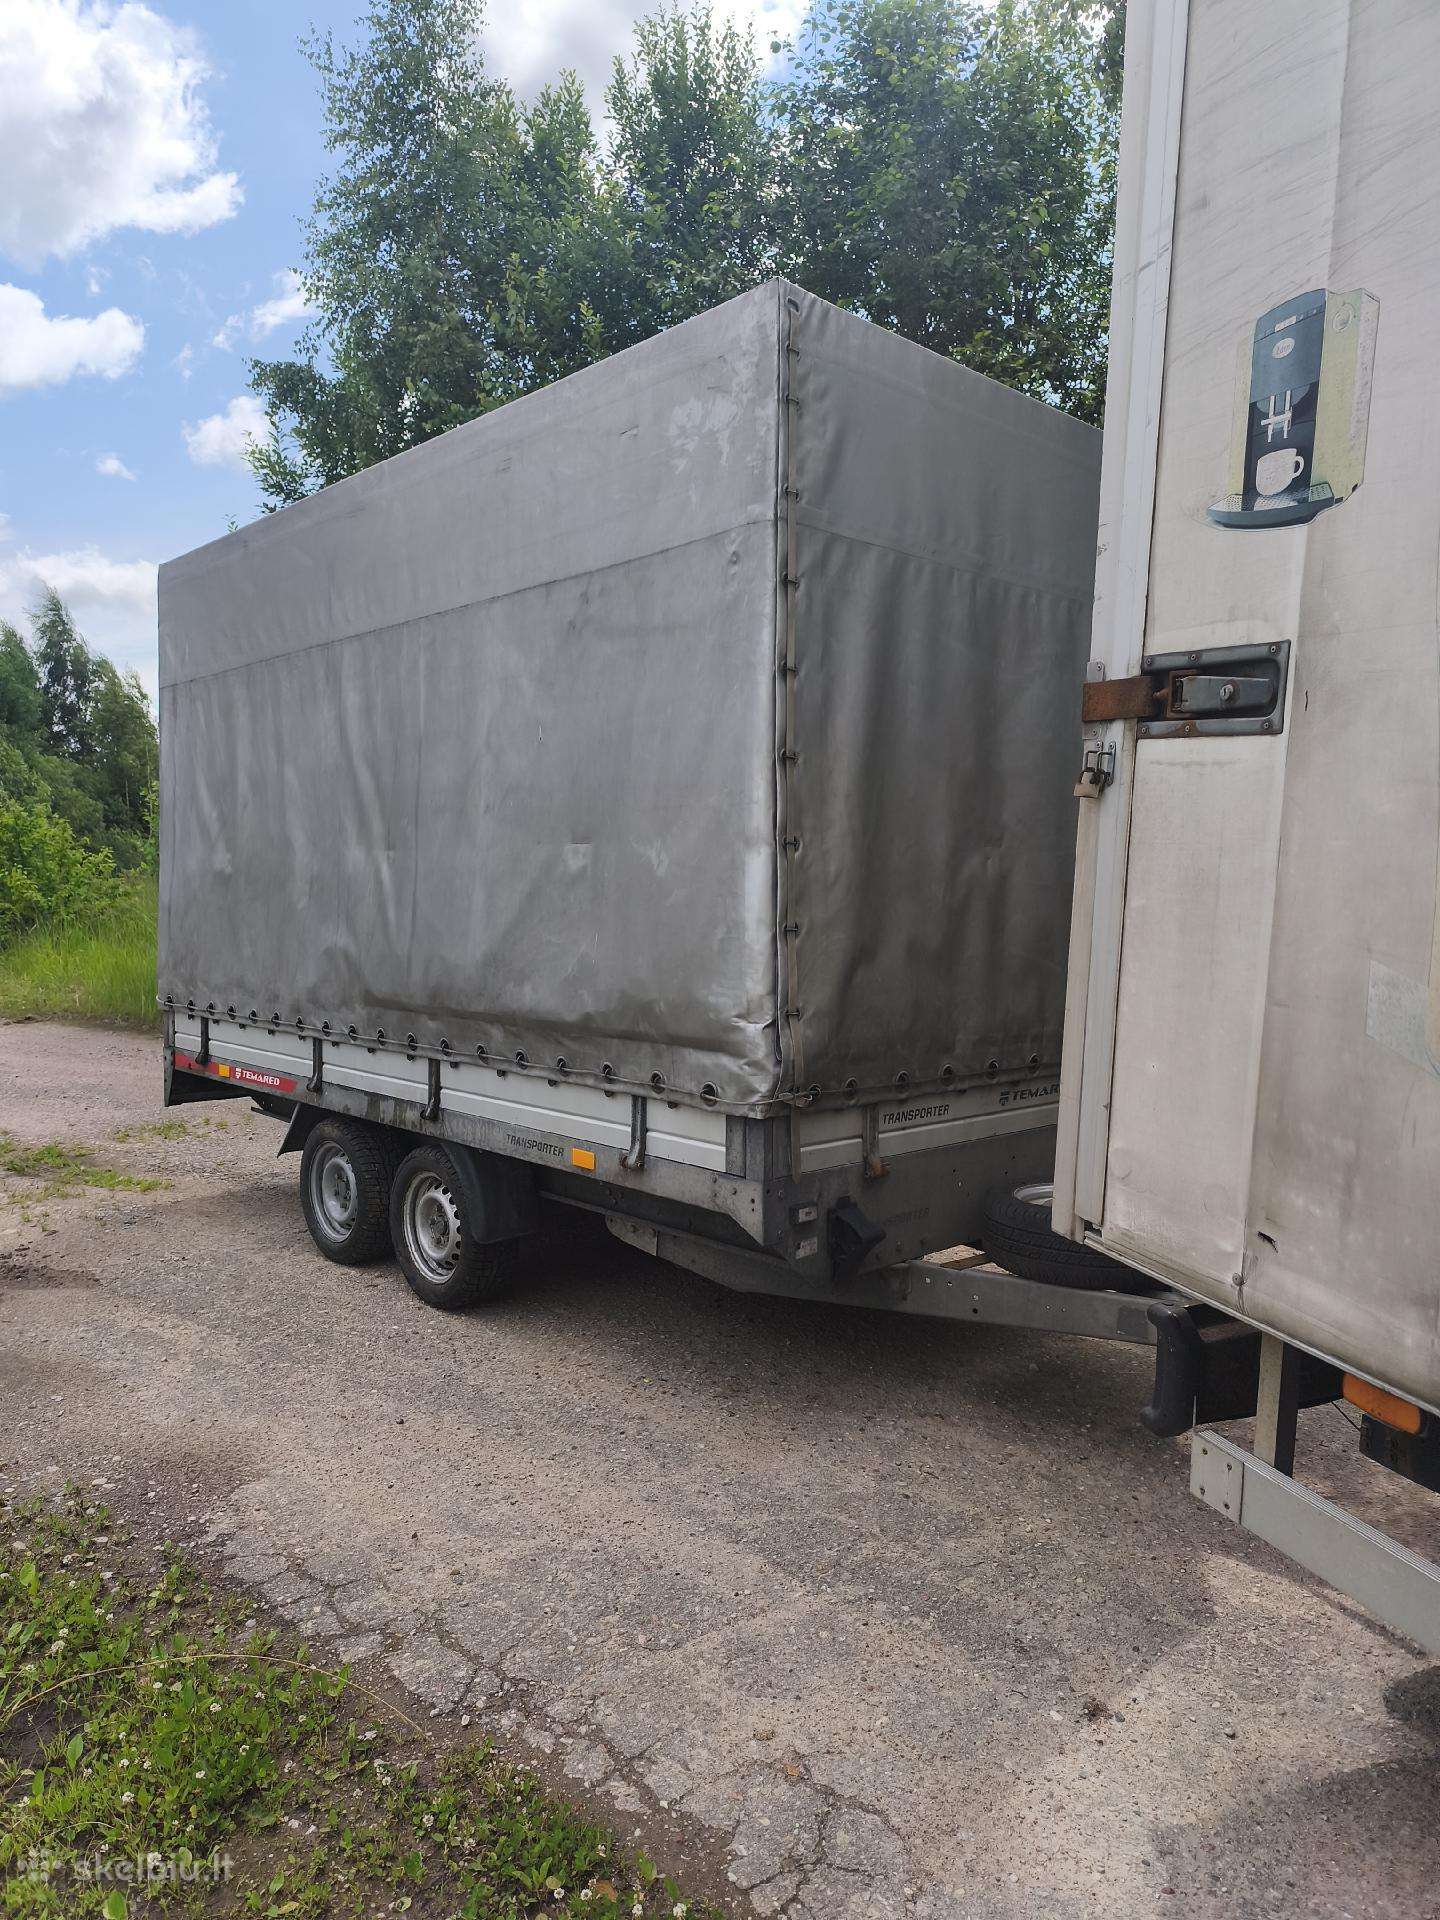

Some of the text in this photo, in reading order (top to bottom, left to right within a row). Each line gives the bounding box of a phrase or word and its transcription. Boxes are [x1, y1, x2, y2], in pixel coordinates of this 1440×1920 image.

[242, 1070, 280, 1086] TEMARED
[883, 1104, 950, 1125] TRANSPORTER
[506, 1133, 565, 1157] TRANSPORTER
